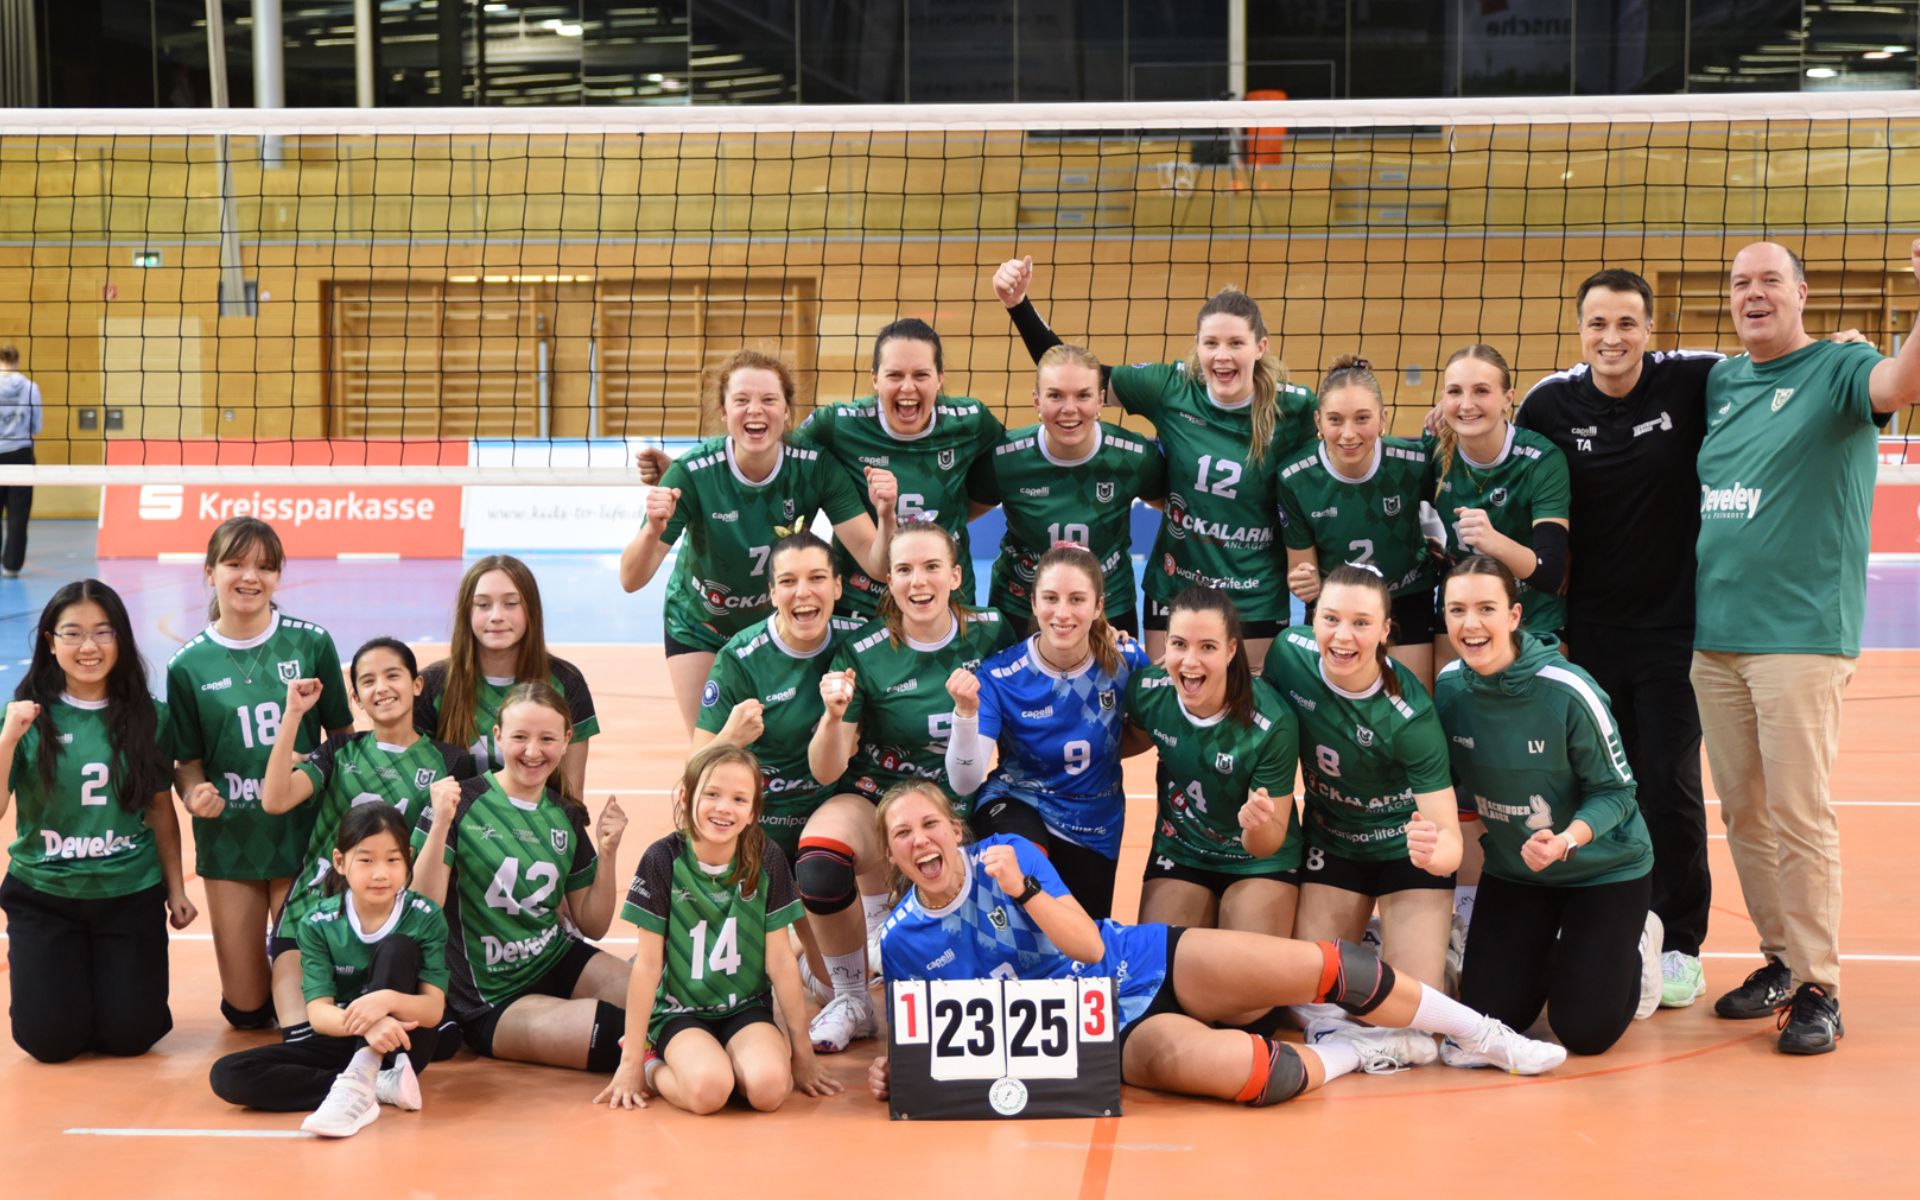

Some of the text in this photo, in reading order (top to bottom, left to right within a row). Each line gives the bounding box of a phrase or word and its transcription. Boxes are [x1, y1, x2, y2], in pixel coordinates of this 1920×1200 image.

[1571, 426, 1597, 436] capelli
[1576, 439, 1592, 452] TA
[858, 456, 890, 466] capelli
[1194, 454, 1242, 500] 12
[1020, 487, 1050, 497] capelli
[199, 491, 435, 527] Kreissparkasse
[712, 510, 739, 522] capelli
[749, 545, 771, 577] 7
[201, 677, 233, 691] capelli
[766, 687, 797, 702] capelli
[1021, 705, 1054, 719] capelli
[1290, 690, 1317, 712] capelli
[237, 701, 282, 748] 18
[1063, 739, 1091, 776] 9
[1528, 740, 1545, 753] LV
[1316, 743, 1342, 778] 8
[81, 762, 109, 806] 2
[1186, 780, 1208, 814] 4
[1306, 847, 1325, 871] 8
[484, 856, 559, 918] 42
[689, 916, 742, 980] 14
[926, 948, 956, 971] capelli
[900, 989, 1106, 1058] 1 23 25 3
